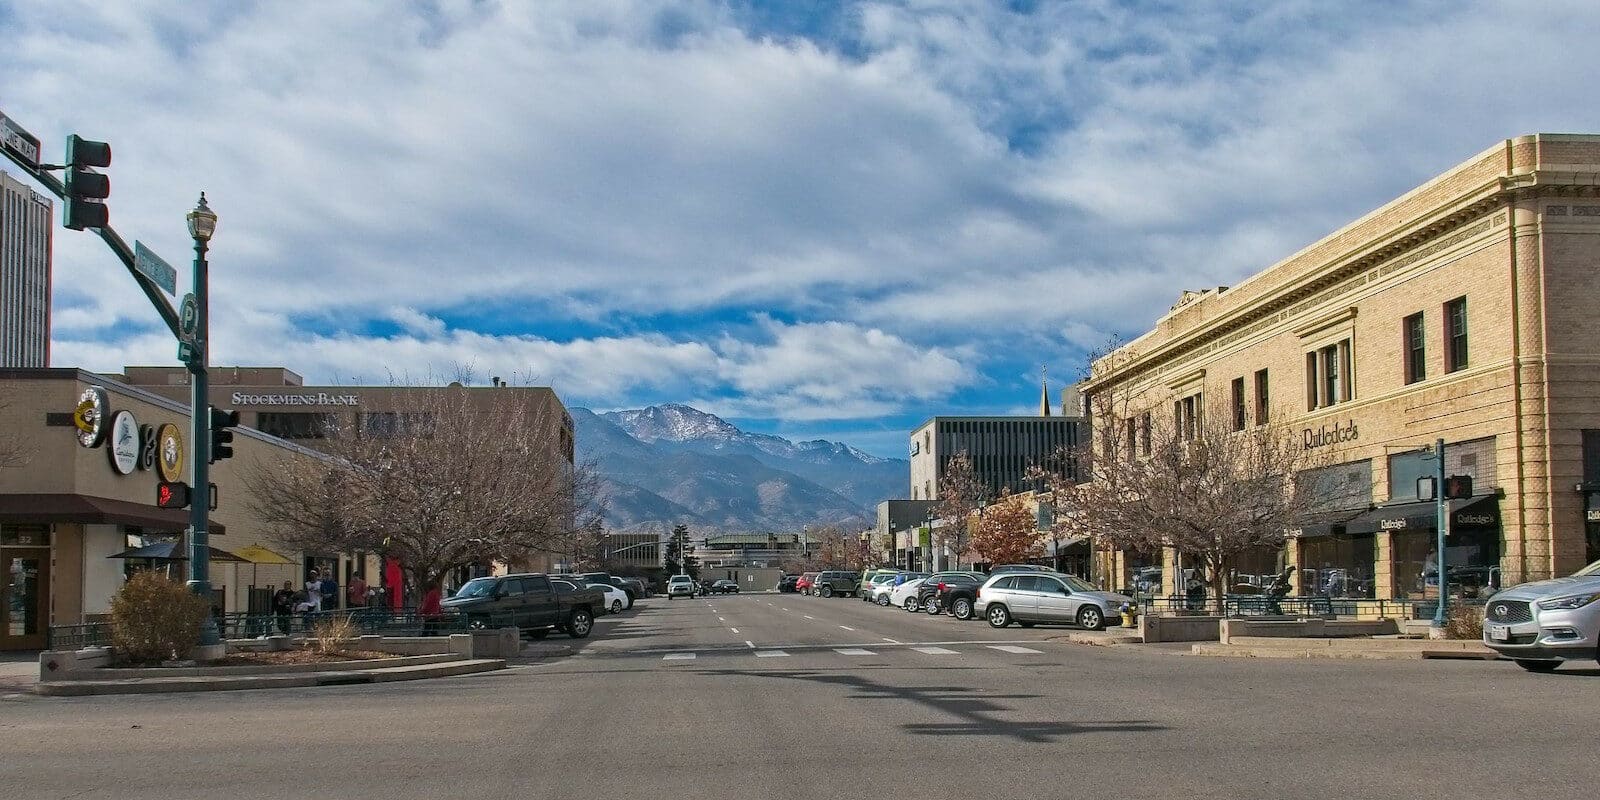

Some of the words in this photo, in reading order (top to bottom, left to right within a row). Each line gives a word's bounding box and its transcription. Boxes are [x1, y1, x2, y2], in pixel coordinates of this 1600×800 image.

[184, 305, 193, 329] P
[231, 391, 315, 405] STOCKMENS
[317, 392, 359, 406] BANK
[18, 535, 33, 544] 32
